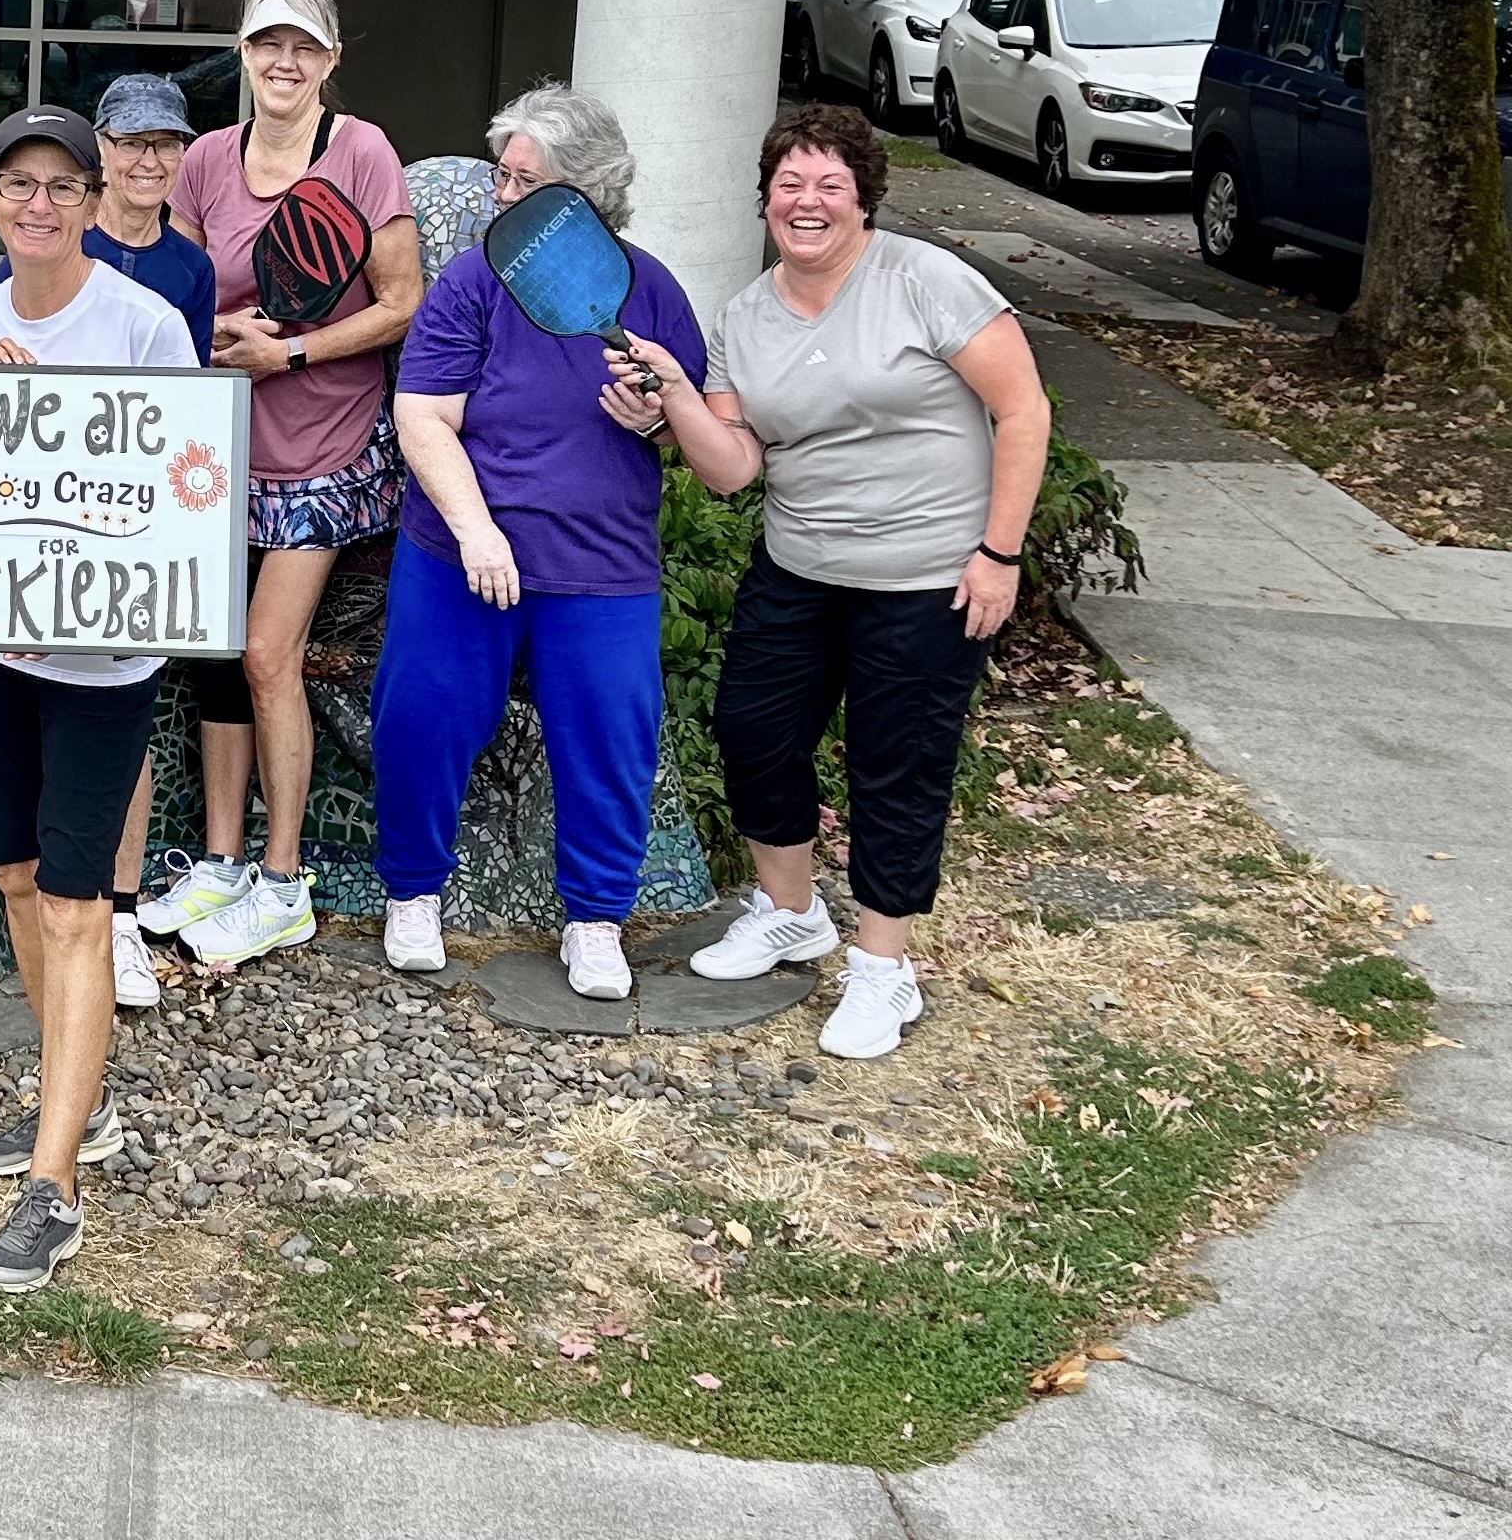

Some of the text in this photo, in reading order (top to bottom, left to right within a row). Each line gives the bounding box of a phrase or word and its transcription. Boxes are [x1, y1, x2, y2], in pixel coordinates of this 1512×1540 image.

[500, 206, 575, 282] STRYKER
[85, 390, 166, 456] are
[54, 471, 154, 513] Crazy
[39, 539, 79, 555] FOR
